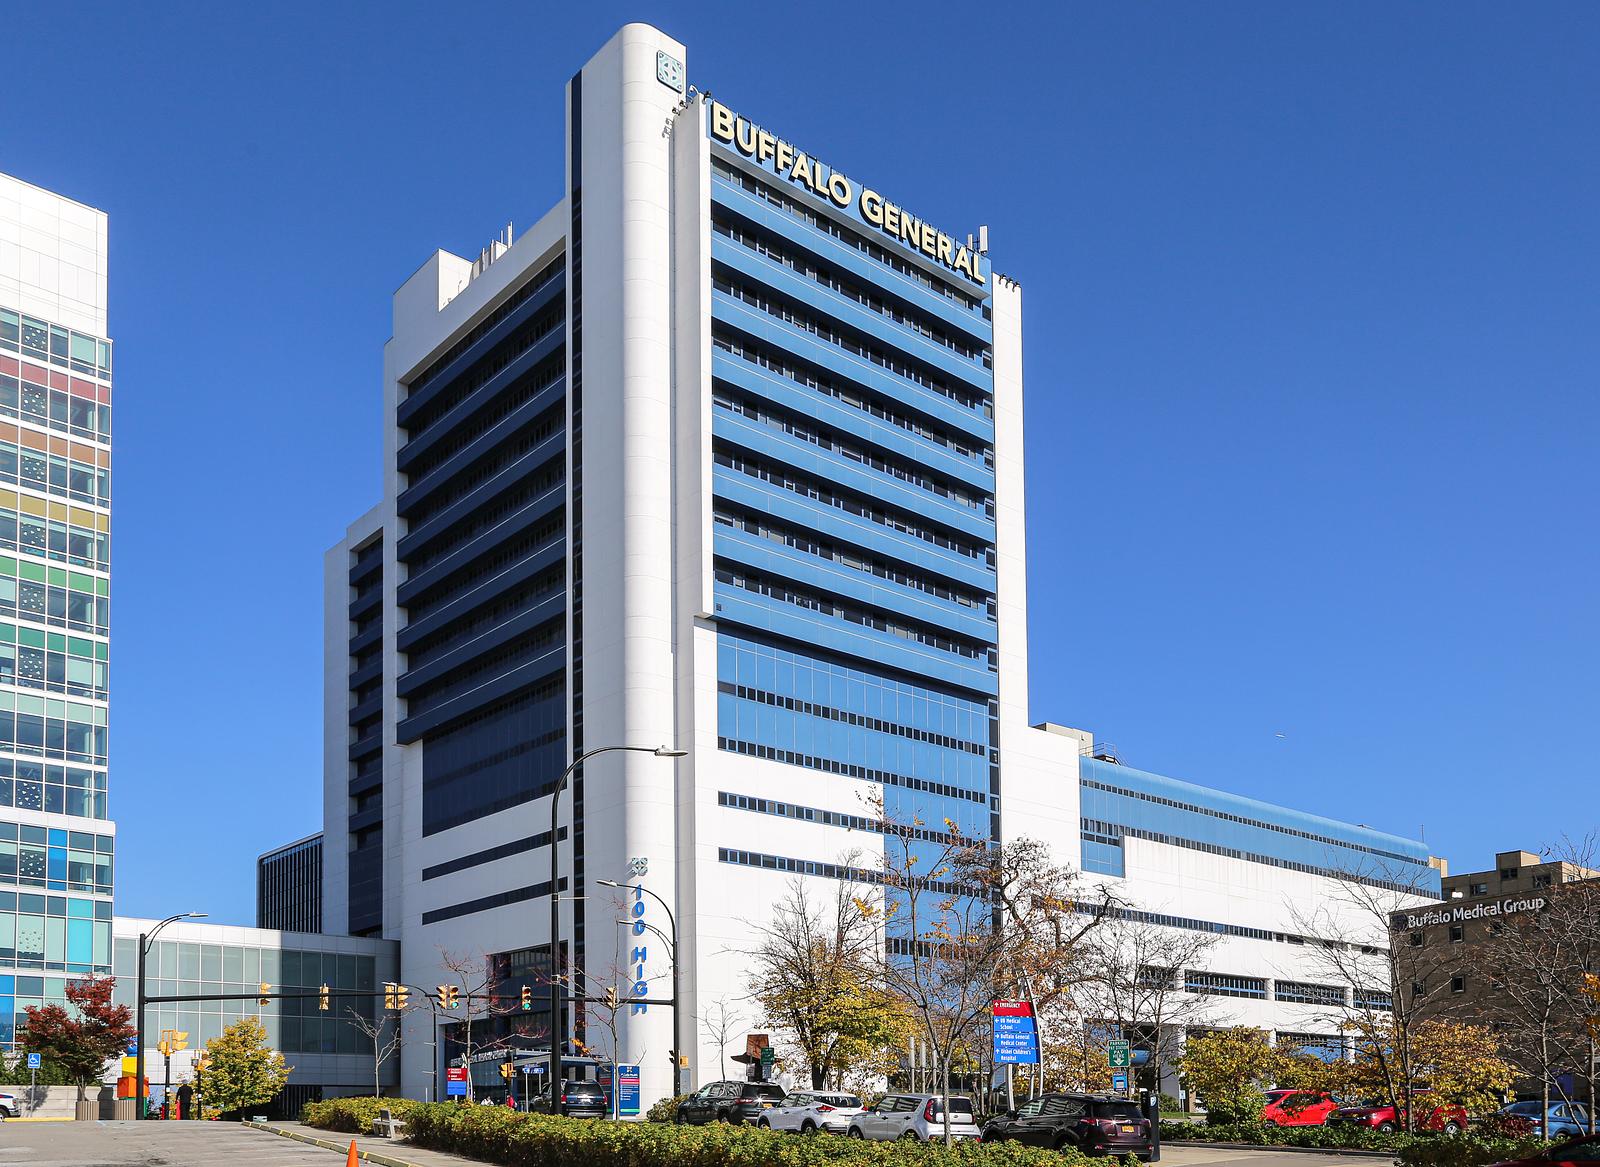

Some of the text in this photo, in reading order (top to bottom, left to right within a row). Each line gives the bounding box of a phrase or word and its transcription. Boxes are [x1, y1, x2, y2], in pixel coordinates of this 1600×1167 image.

[712, 101, 986, 284] BUFFALO GENERAL
[1408, 897, 1545, 928] Buffalo Medical Group
